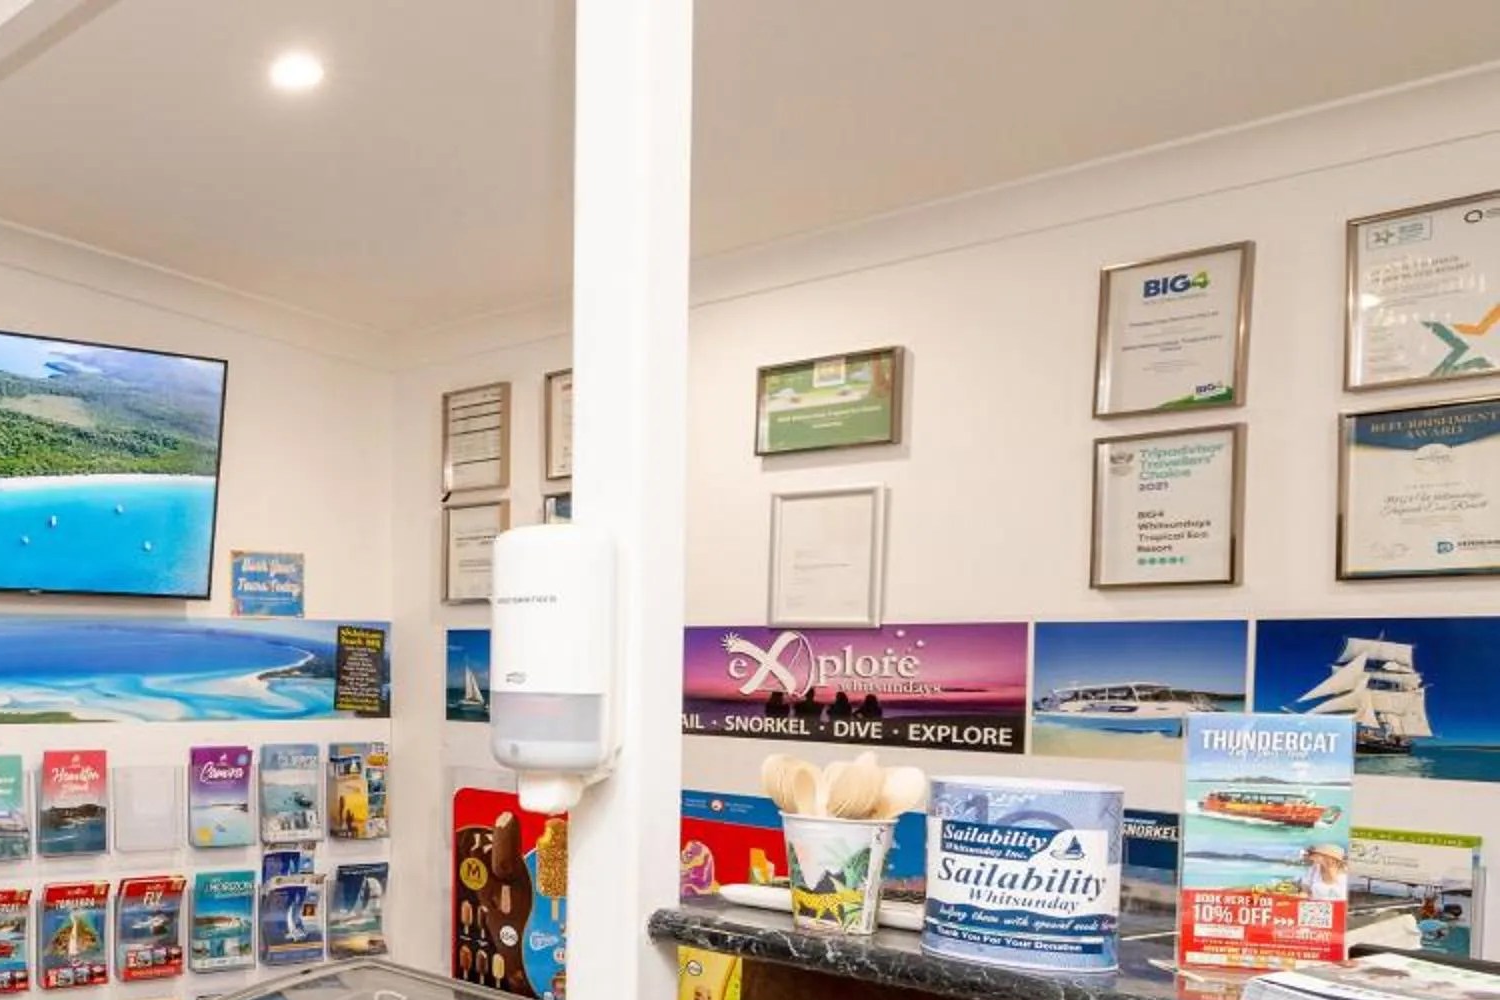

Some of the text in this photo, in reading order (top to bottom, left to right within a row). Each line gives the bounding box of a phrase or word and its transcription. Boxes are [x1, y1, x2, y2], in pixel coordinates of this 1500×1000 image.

[1138, 468, 1192, 481] Choice
[1138, 481, 1170, 492] 2021
[1137, 519, 1212, 531] Whitsundays
[1138, 532, 1185, 542] Tropical
[1137, 545, 1173, 553] Resort
[681, 715, 1013, 746] AIL SNORKEL DIVE EXPLORE
[1202, 729, 1340, 753] THUNDERCAT
[943, 822, 1048, 850] Sailability
[1004, 849, 1028, 860] Inc.
[937, 857, 1107, 902] Sailability
[968, 887, 1080, 914] Whitsunday
[1221, 895, 1251, 905] HERE
[1252, 896, 1273, 906] FOR
[1003, 915, 1030, 927] with
[1193, 905, 1273, 927] 10% OFF
[961, 930, 981, 942] You
[982, 934, 1001, 945] For
[1005, 937, 1032, 948] Your
[1034, 941, 1083, 952] Donation
